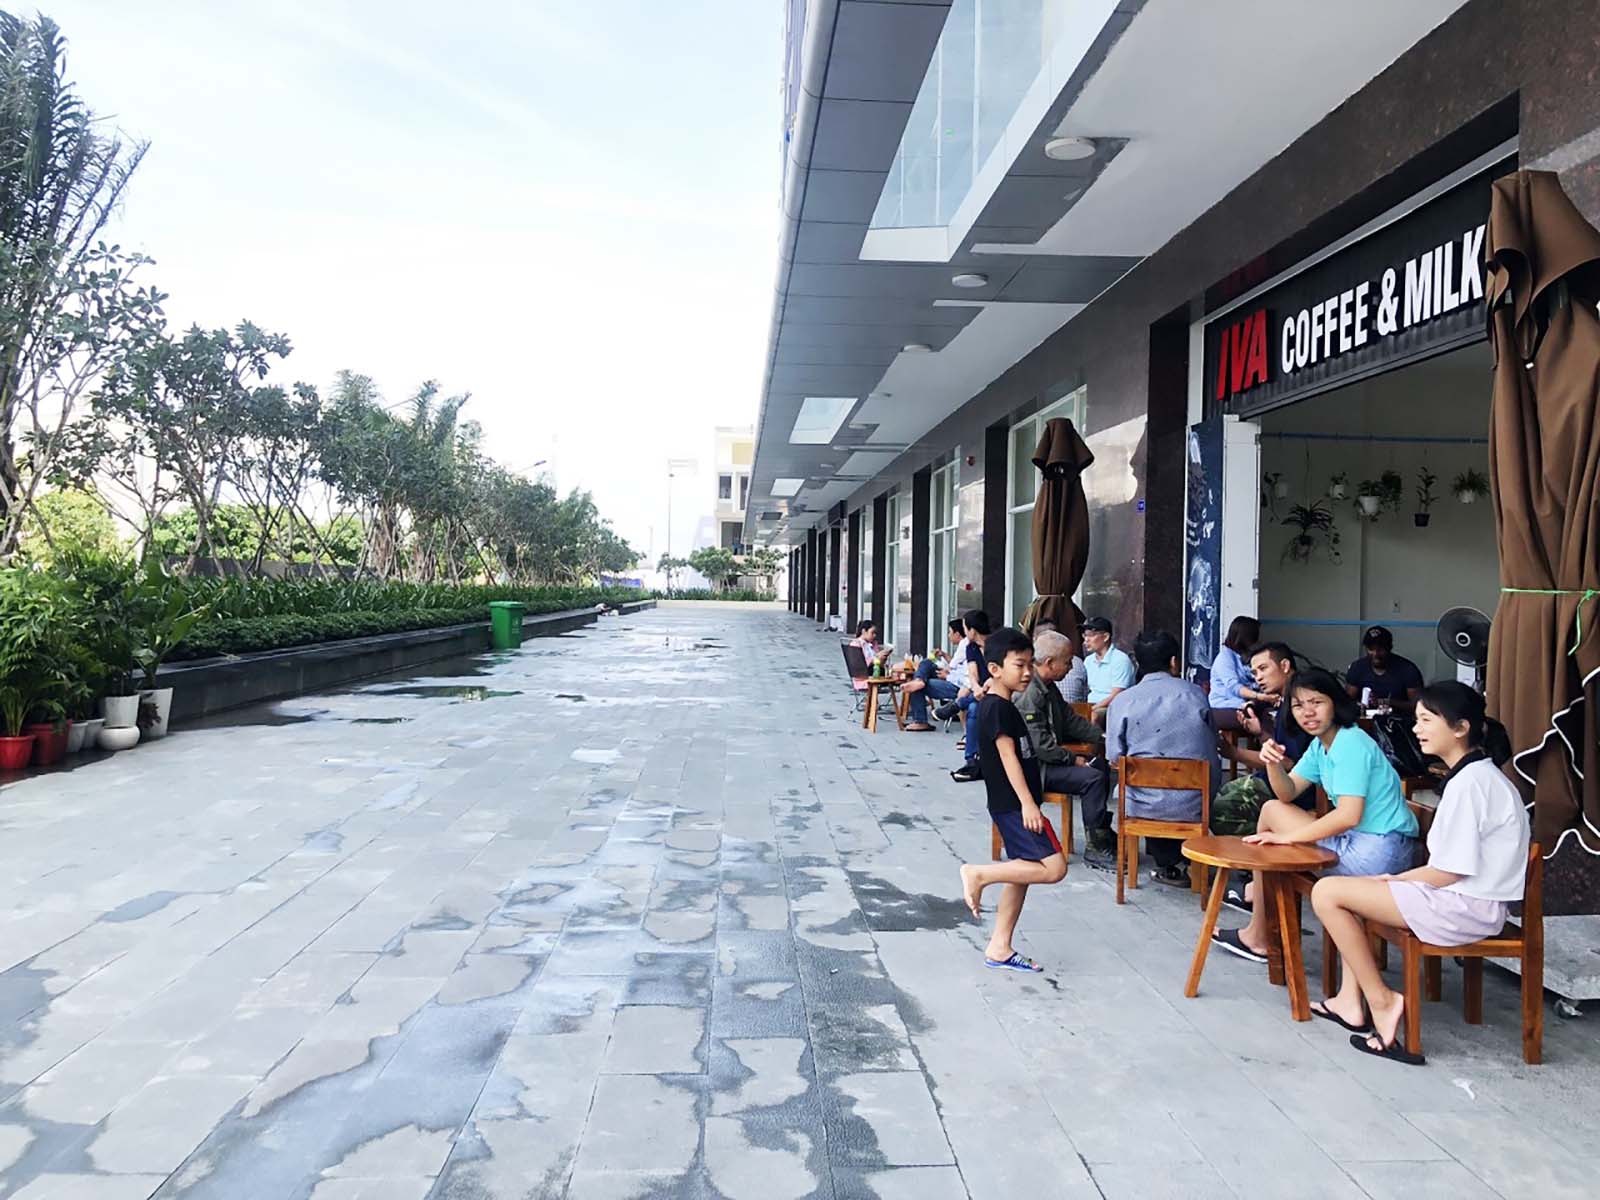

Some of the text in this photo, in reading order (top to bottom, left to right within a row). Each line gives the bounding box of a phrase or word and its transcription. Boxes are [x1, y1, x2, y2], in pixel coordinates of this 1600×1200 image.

[1216, 223, 1486, 400] IVA COFFEE & MILK
